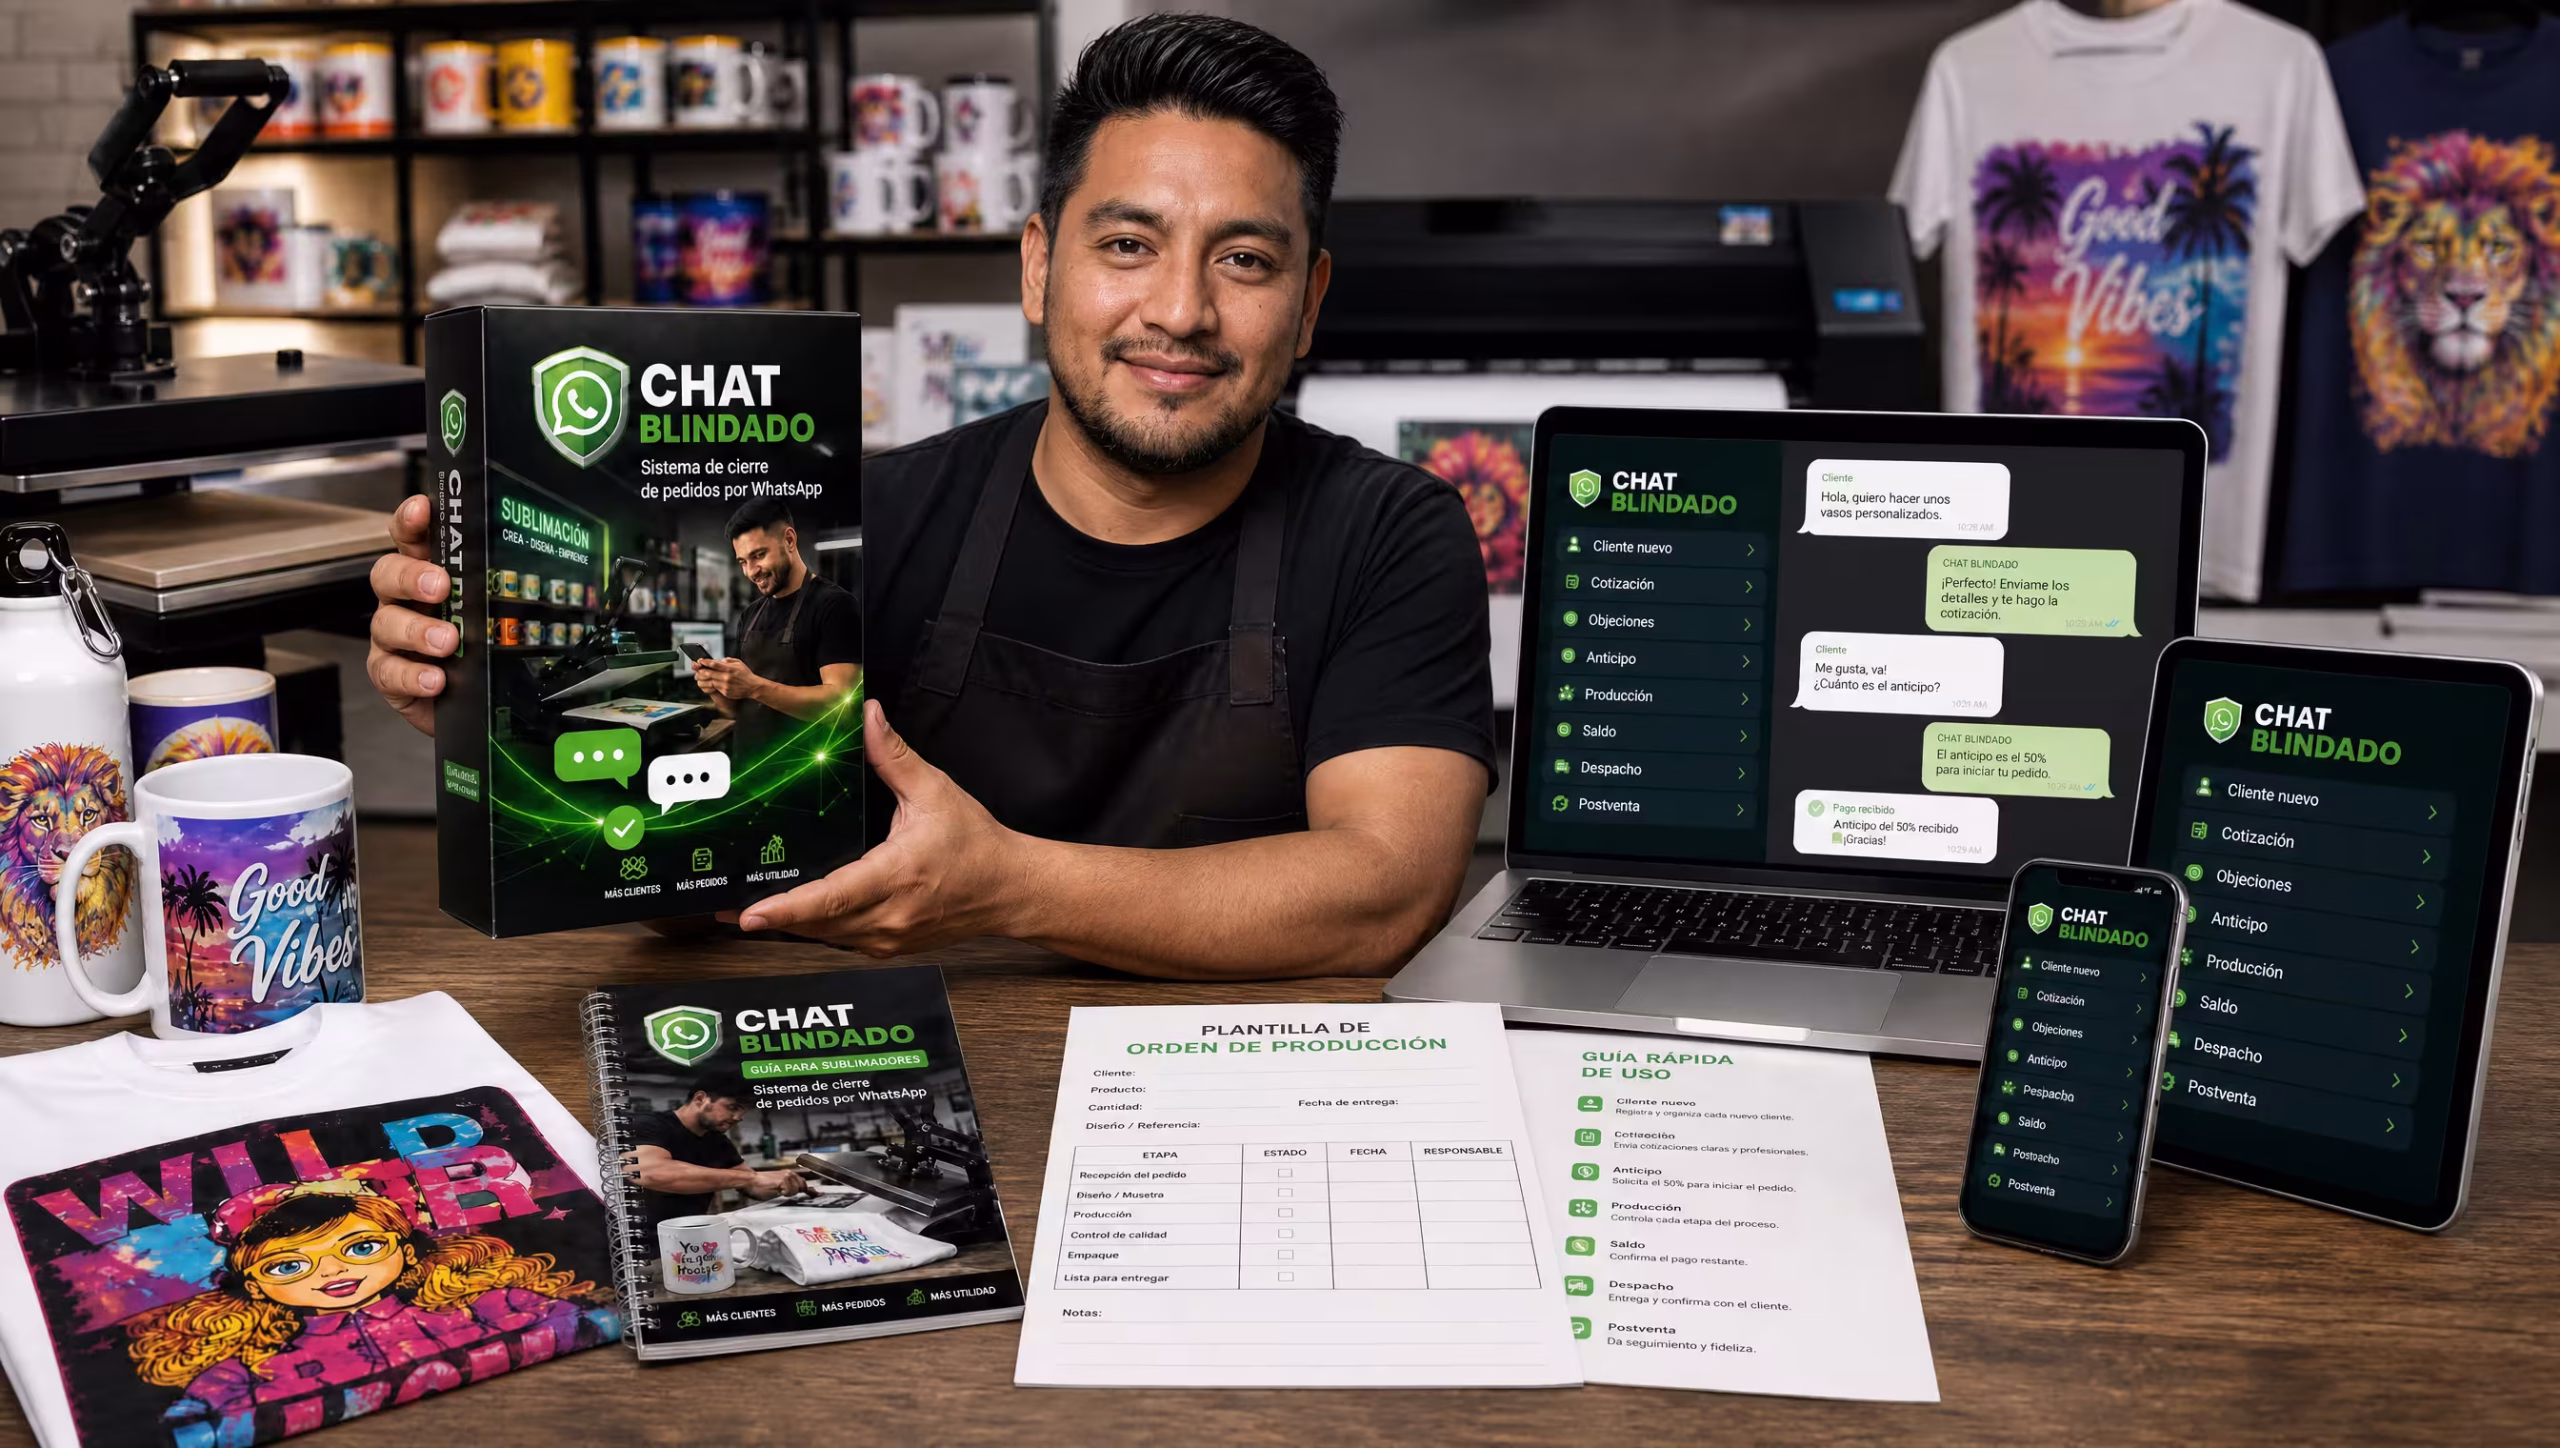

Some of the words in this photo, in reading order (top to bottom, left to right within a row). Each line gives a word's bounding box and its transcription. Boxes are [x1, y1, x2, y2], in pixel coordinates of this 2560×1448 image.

[2055, 177, 2176, 262] Good
[2053, 250, 2203, 341] Vibes
[640, 363, 780, 407] CHAT
[640, 412, 815, 443] BLINDADO
[641, 459, 700, 475] Sistema
[705, 459, 724, 474] de
[728, 458, 768, 473] cierre
[1612, 471, 1677, 491] CHAT
[1822, 474, 1853, 483] Cliente
[641, 483, 659, 498] de
[663, 482, 721, 501] pedidos
[724, 485, 748, 500] por
[751, 481, 823, 499] WhatsApp
[1821, 492, 1849, 504] Hola,
[1889, 493, 1920, 504] hacer
[1923, 496, 1950, 504] unos
[1611, 492, 1737, 515] BLINDADO
[449, 469, 463, 572] CHAT
[1820, 510, 1852, 519] vasos
[1855, 507, 1942, 521] personalizados.
[502, 497, 589, 549] SUBLIMACIÓN
[502, 528, 524, 545] CREA
[1593, 540, 1634, 554] Cliente
[1637, 543, 1672, 554] nuevo
[1591, 577, 1655, 591] Cotización
[1941, 577, 1996, 590] ¡Perfecto!
[2052, 580, 2070, 591] los
[1941, 592, 1988, 604] detalles
[1992, 596, 1998, 606] y
[2002, 595, 2013, 605] te
[2016, 594, 2045, 608] hago
[2048, 595, 2058, 606] la
[1940, 607, 2001, 620] cotización.
[1588, 614, 1655, 630] Objeciones
[1816, 645, 1847, 654] Cliente
[1586, 652, 1636, 667] Anticipo
[1815, 664, 1833, 674] Me
[1836, 665, 1868, 677] gusta,
[1871, 664, 1887, 675] va!
[1813, 677, 1859, 692] ¿Cuánto
[1862, 682, 1875, 691] es
[1878, 680, 1887, 691] el
[1890, 680, 1941, 694] anticipo?
[1585, 688, 1653, 703] Producción
[2254, 703, 2332, 730] CHAT
[1583, 725, 1616, 738] Saldo
[2251, 729, 2401, 765] BLINDADO
[1937, 749, 1947, 760] El
[1950, 750, 1993, 763] anticipo
[1995, 754, 2008, 762] es
[2011, 752, 2021, 762] el
[2024, 752, 2047, 763] 50%
[1581, 761, 1642, 776] Despacho
[1936, 767, 1960, 777] para
[1963, 765, 1995, 776] iniciar
[1998, 767, 2008, 777] tu
[2011, 766, 2051, 779] pedido.
[2227, 783, 2274, 801] Cliente
[2278, 790, 2319, 807] nuevo
[1579, 798, 1640, 812] Postventa
[1833, 804, 1856, 815] Pago
[1859, 804, 1895, 815] recibido
[1833, 820, 1876, 832] Anticipo
[1879, 821, 1894, 831] del
[1897, 822, 1916, 832] 50%
[1919, 823, 1959, 834] recibido
[2221, 826, 2295, 848] Cotización
[2216, 869, 2292, 892] Objeciones
[227, 854, 330, 940] Good
[2061, 907, 2107, 926] CHAT
[2211, 912, 2268, 933] Anticipo
[2059, 923, 2149, 948] BLINDADO
[230, 920, 358, 1004] Vibes
[2041, 960, 2071, 975] Cliente
[2073, 965, 2100, 977] nuevo
[2206, 954, 2283, 980] Producción
[2037, 990, 2085, 1006] Cotización
[2200, 995, 2238, 1015] Saldo
[735, 1003, 854, 1032] CHAT
[1201, 1023, 1330, 1037] PLANTILLA
[1339, 1021, 1370, 1034] DE
[2032, 1022, 2083, 1039] Objeciones
[739, 1024, 915, 1054] BLINDADO
[1126, 1041, 1219, 1056] ORDEN
[1229, 1041, 1261, 1054] DE
[1272, 1036, 1447, 1052] PRODUCCIÓN
[1582, 1049, 1637, 1063] GUÍA
[1646, 1050, 1734, 1065] RÁPIDA
[2194, 1037, 2262, 1064] Despacho
[750, 1061, 781, 1075] GUÍA
[785, 1060, 818, 1073] PARA
[822, 1055, 920, 1071] SUBLIMADORES
[2027, 1054, 2067, 1069] Anticipo
[1582, 1067, 1612, 1078] DE
[1622, 1067, 1671, 1080] USO
[753, 1082, 808, 1096] Sistema
[812, 1080, 828, 1092] de
[832, 1078, 870, 1091] cierre
[1091, 1086, 1145, 1094] Producto:
[2188, 1079, 2257, 1106] Postventa
[756, 1096, 772, 1109] de
[777, 1093, 829, 1109] pedidos
[833, 1093, 856, 1107] por
[859, 1086, 927, 1101] WhatsApp
[1298, 1099, 1331, 1107] Fecha
[1337, 1098, 1350, 1106] de
[1353, 1098, 1398, 1108] entrega:
[1088, 1103, 1142, 1111] Cantidad:
[1264, 1149, 1307, 1157] ESTADO
[1350, 1148, 1387, 1156] FECHA
[1424, 1147, 1503, 1155] RESPONSABLE
[1613, 1166, 1662, 1176] Anticipo
[2008, 1178, 2055, 1197] Postventa
[1611, 1202, 1682, 1212] Producción
[1070, 1231, 1110, 1239] Control
[1113, 1231, 1126, 1239] de
[1129, 1231, 1167, 1239] calidad
[1610, 1240, 1645, 1249] Saldo
[1067, 1252, 1119, 1260] Empaque
[1064, 1274, 1090, 1282] Lista
[1093, 1275, 1118, 1283] para
[1121, 1275, 1169, 1283] entregar
[1609, 1280, 1674, 1291] Despacho
[930, 1287, 952, 1300] MÁS
[954, 1286, 996, 1298] UTILIDAD
[822, 1299, 843, 1312] MÁS
[845, 1298, 886, 1310] PEDIDOS
[1608, 1294, 1650, 1304] Entrega
[1652, 1297, 1659, 1305] y
[1661, 1296, 1710, 1307] confirma
[1713, 1300, 1734, 1308] con
[1737, 1299, 1747, 1308] el
[1750, 1301, 1792, 1311] cliente.
[706, 1309, 728, 1322] MÁS
[731, 1308, 776, 1321] CLIENTES
[1062, 1308, 1102, 1318] Notas:
[1608, 1323, 1676, 1335] Postventa
[1607, 1337, 1622, 1346] Da
[1626, 1338, 1697, 1351] seguimiento
[1700, 1343, 1707, 1352] y
[1710, 1341, 1756, 1354] fideliza.
